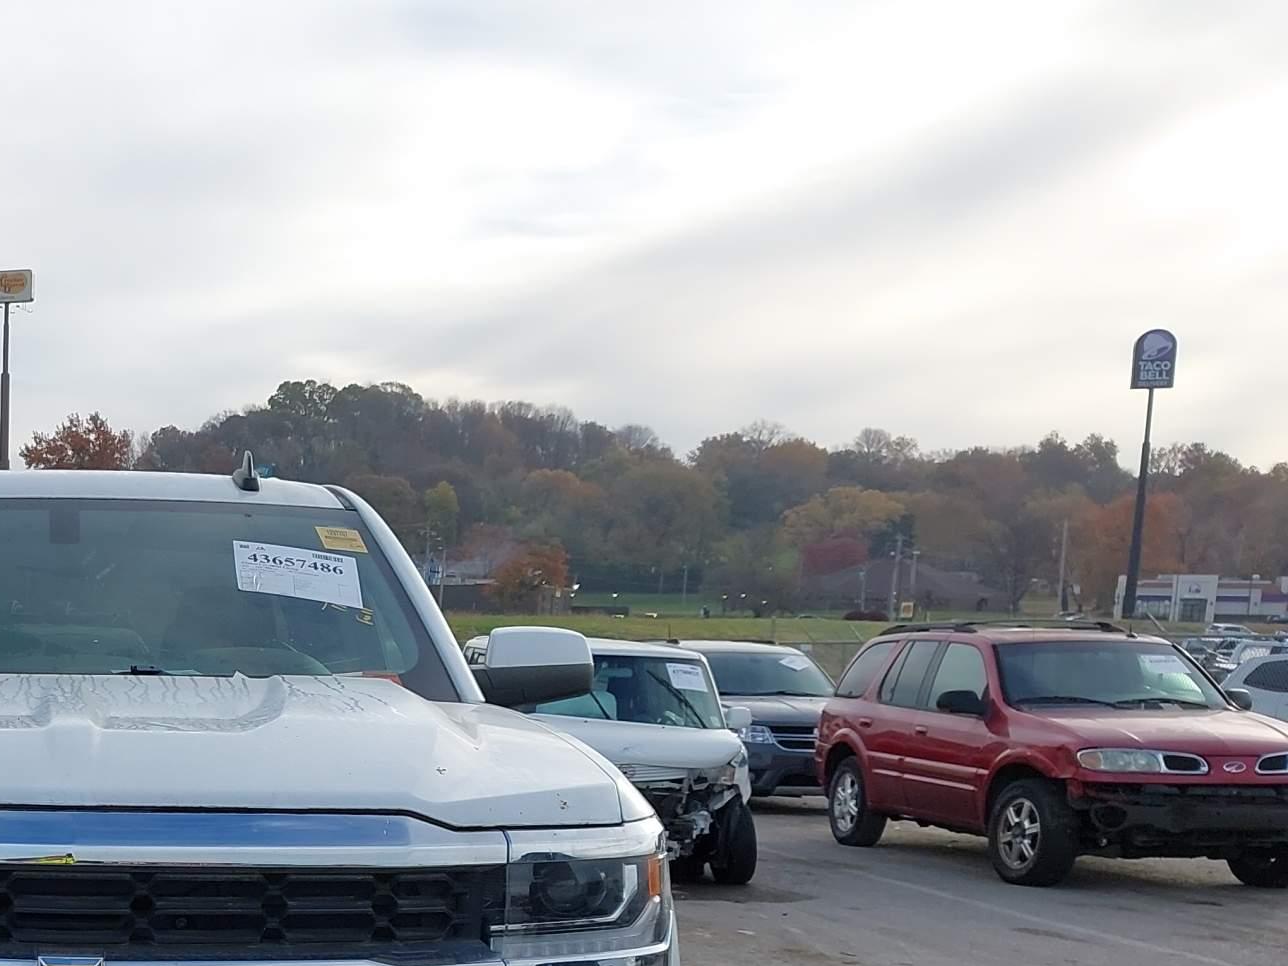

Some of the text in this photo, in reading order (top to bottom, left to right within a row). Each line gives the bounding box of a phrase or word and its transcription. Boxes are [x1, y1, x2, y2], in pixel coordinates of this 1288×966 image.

[1138, 361, 1171, 371] TACO
[1139, 370, 1170, 380] BELL
[247, 553, 344, 575] 43657486
